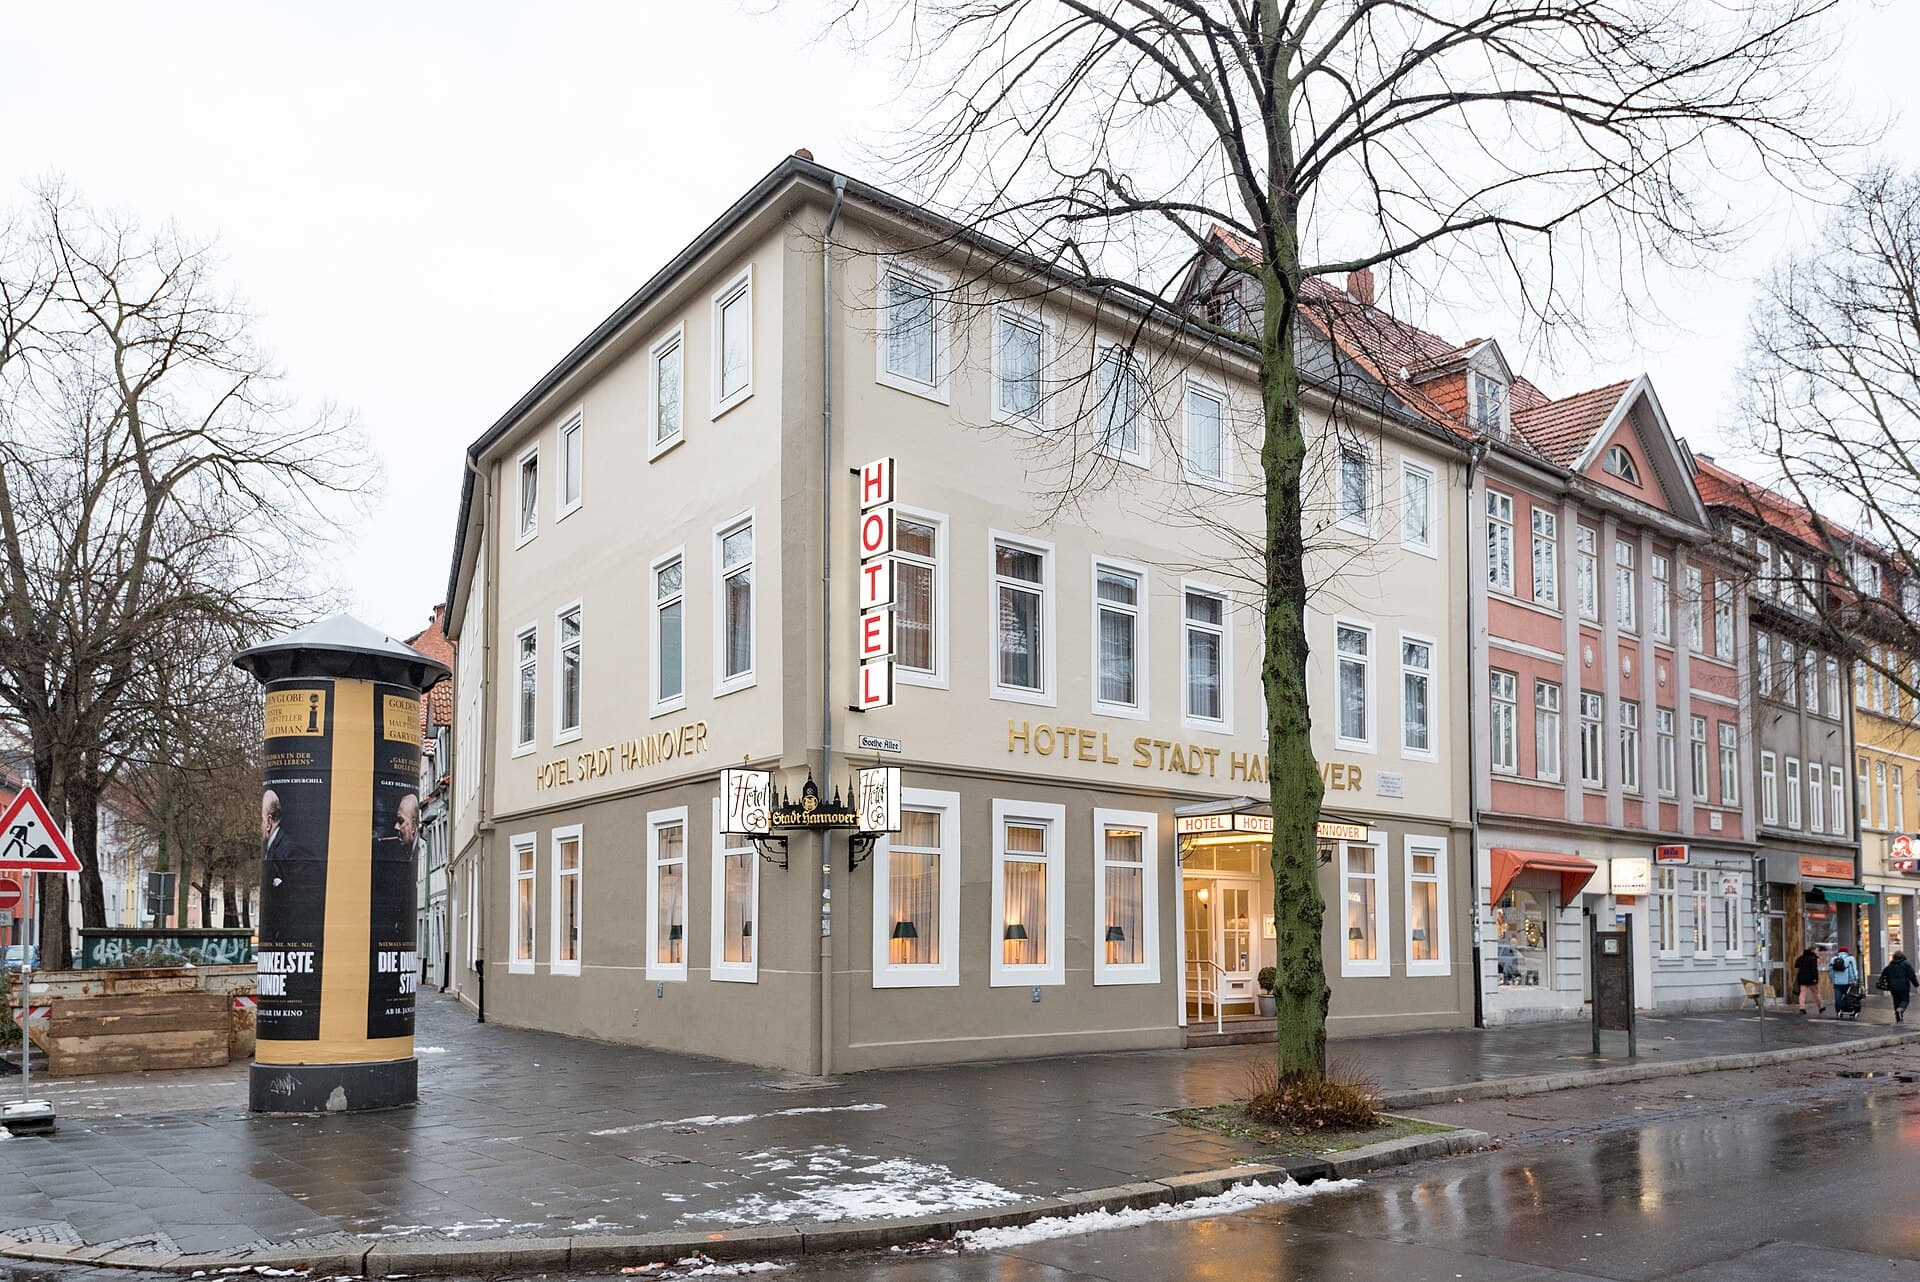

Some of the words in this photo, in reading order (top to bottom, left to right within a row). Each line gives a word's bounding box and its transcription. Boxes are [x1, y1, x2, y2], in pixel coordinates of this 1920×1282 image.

[863, 462, 883, 704] HOTEL
[276, 693, 305, 704] GLOBE
[861, 736, 883, 748] Goethe
[884, 738, 899, 750] Allee
[537, 758, 574, 791] HOTEL
[577, 745, 615, 781] STADT
[620, 720, 708, 772] HANNOVER
[1008, 719, 1119, 764] HOTEL
[1133, 736, 1221, 777] STADT
[1231, 751, 1362, 792] HAVER
[730, 773, 768, 828] Hotel
[772, 811, 801, 825] Stadt
[801, 811, 855, 826] Hannover
[1185, 817, 1224, 831] HOTEL
[1316, 824, 1360, 839] ANNOVER
[377, 951, 399, 973] DIE
[273, 1009, 282, 1017] IM
[282, 1009, 303, 1017] KINO
